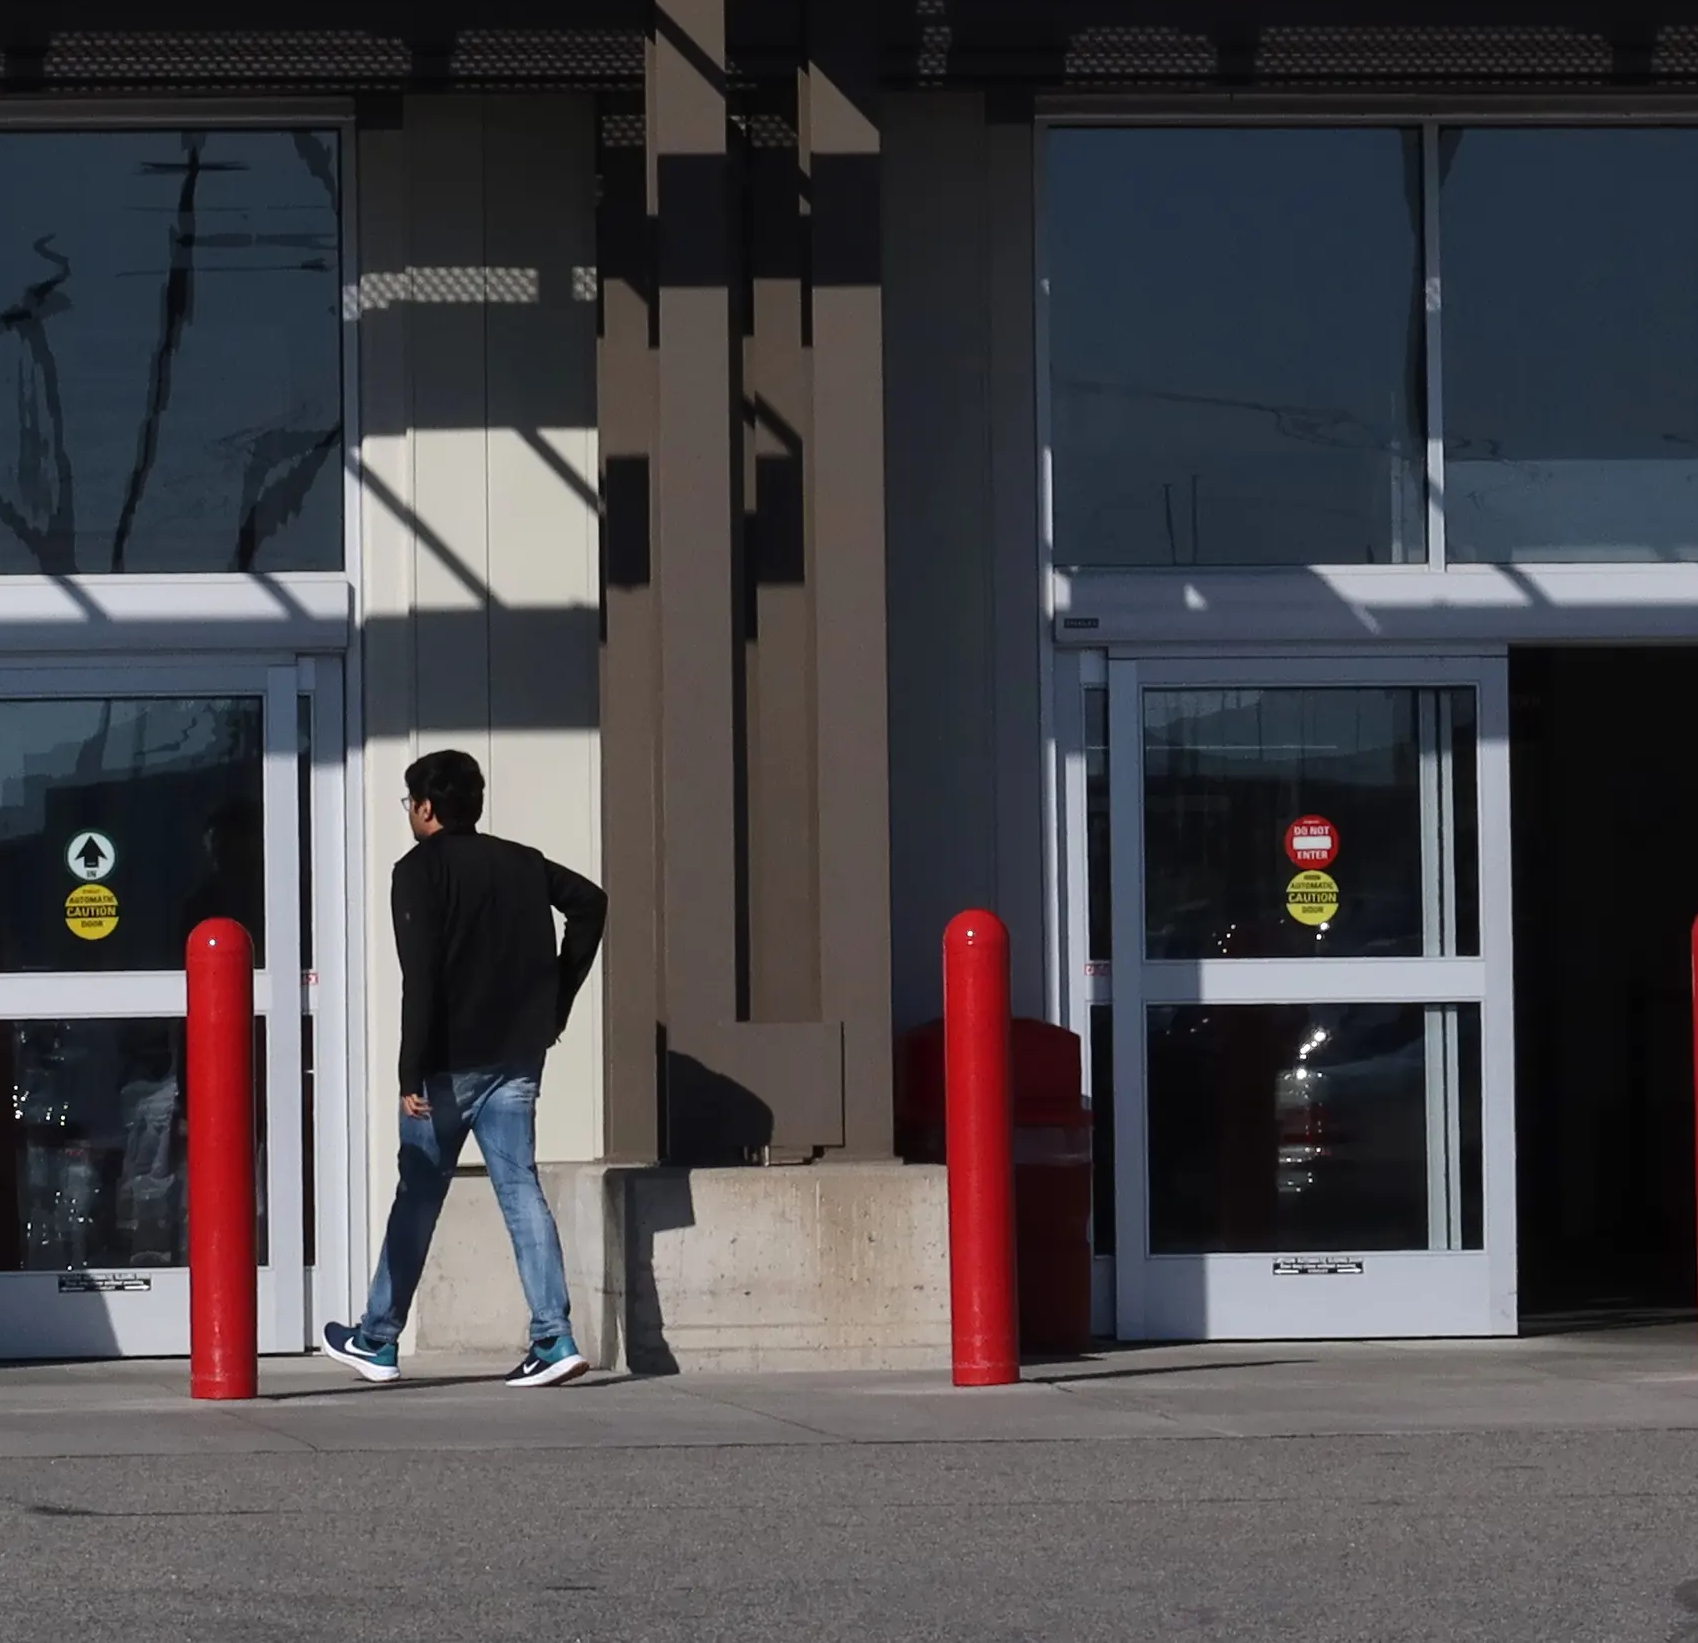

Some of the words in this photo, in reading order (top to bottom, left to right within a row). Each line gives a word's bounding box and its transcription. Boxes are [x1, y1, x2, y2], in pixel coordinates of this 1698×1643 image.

[1294, 826, 1308, 835] DO
[1310, 826, 1330, 835] NOT
[1297, 851, 1329, 860] ENTER
[86, 870, 97, 878] IN
[1288, 893, 1337, 903] CAUTION
[66, 907, 117, 917] CAUTION
